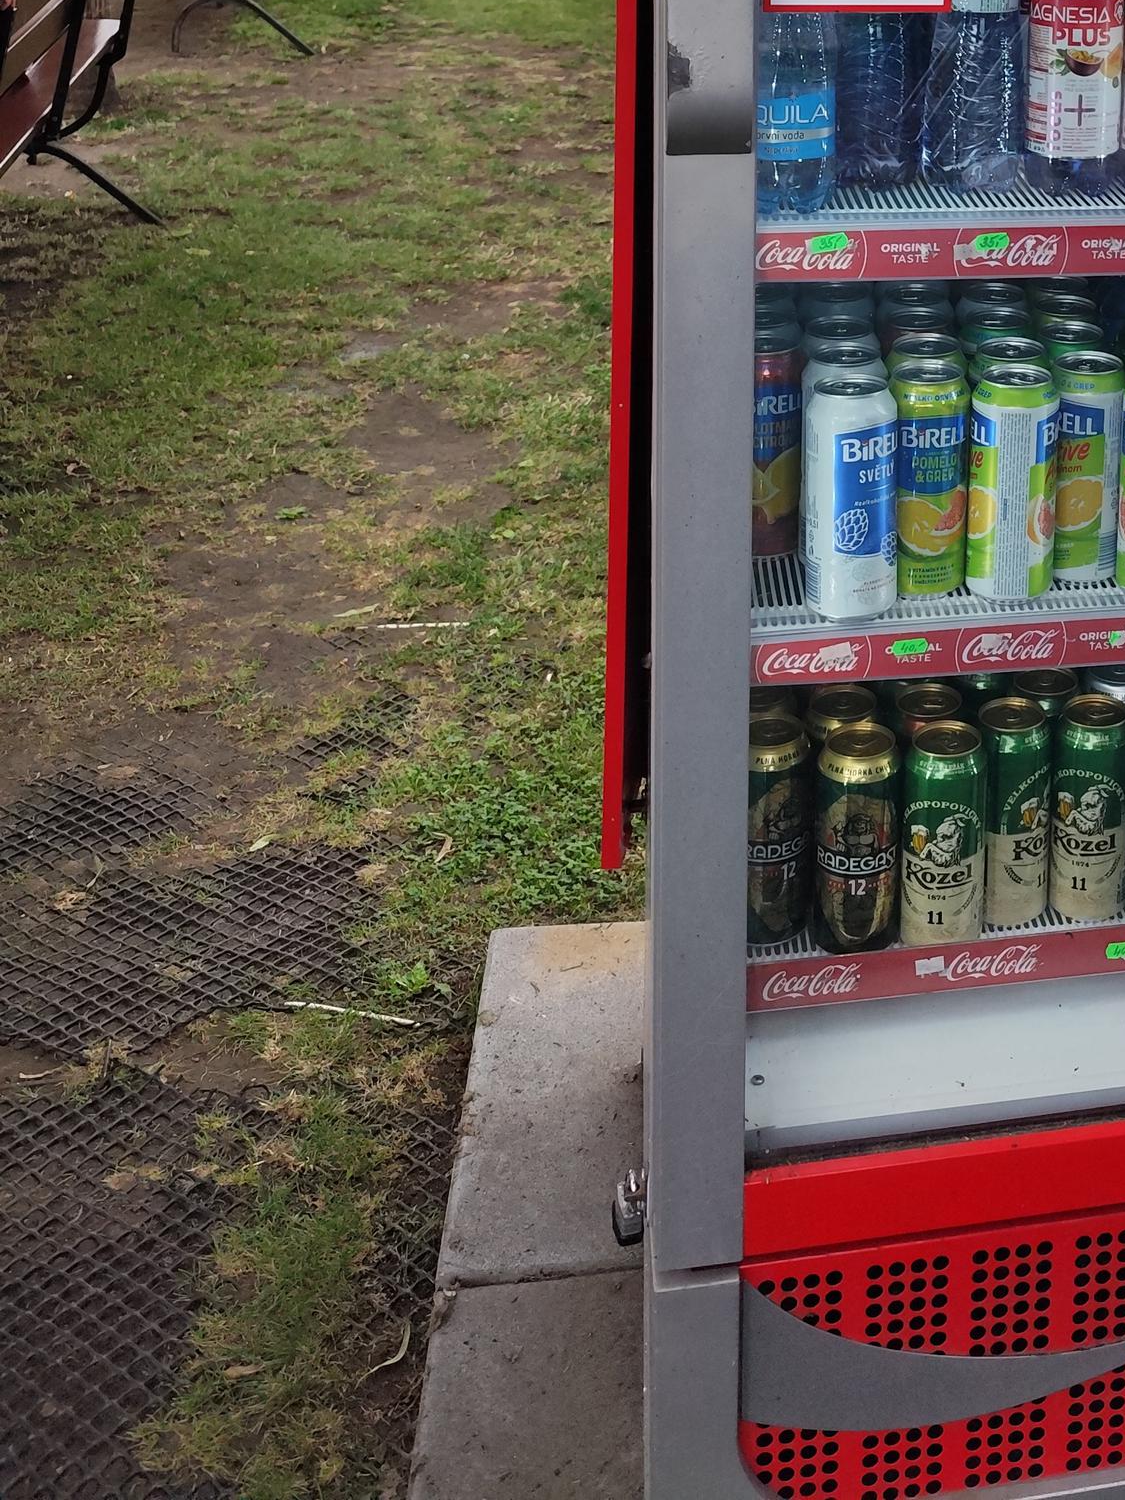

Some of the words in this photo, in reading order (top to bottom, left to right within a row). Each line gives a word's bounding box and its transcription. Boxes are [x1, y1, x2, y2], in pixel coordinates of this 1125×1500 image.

[1052, 27, 1112, 48] PLUS
[756, 102, 829, 126] QUILA
[891, 254, 929, 264] TASTE
[912, 453, 957, 470] POMELO
[859, 459, 895, 484] SVĚTLÝ
[895, 653, 932, 664] TASTE
[780, 860, 797, 881] 12
[905, 857, 973, 889] Kozel
[848, 879, 867, 896] 12
[1071, 876, 1088, 891] 11
[927, 892, 947, 901] 1874
[926, 910, 945, 925] 11
[945, 943, 1042, 982] Coca-Cola
[762, 962, 863, 1001] Coca-Cola
